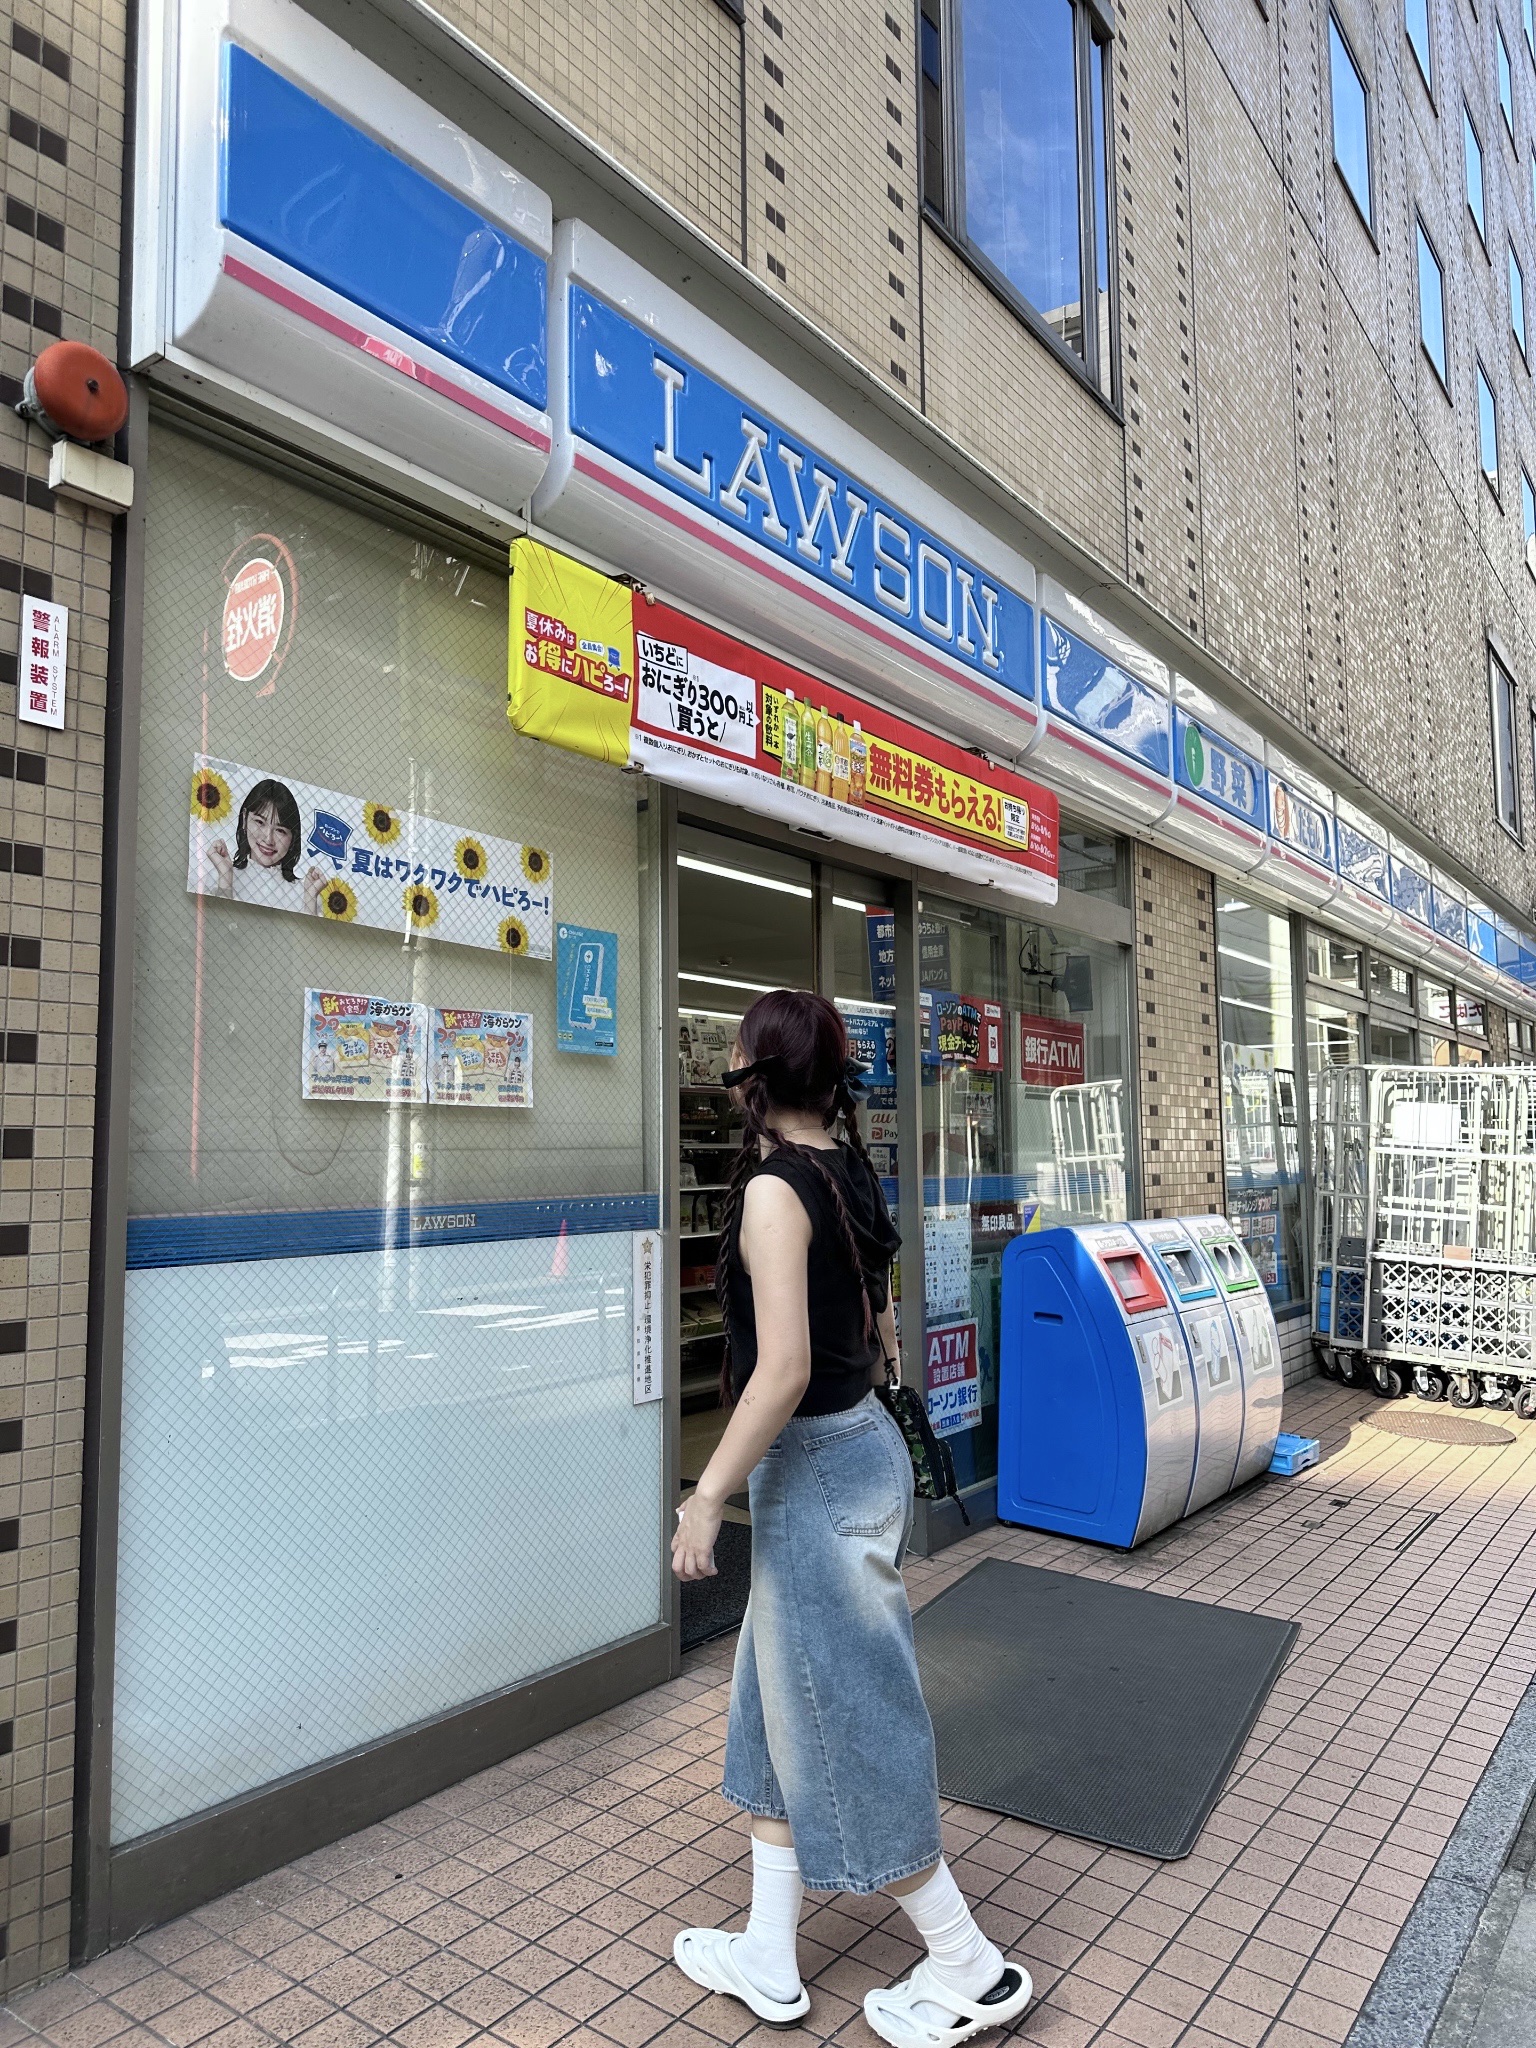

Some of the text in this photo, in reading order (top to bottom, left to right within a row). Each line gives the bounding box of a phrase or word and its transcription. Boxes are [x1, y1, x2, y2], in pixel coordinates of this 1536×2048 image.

[654, 356, 1001, 669] LAWSON
[526, 610, 575, 646] 夏休みは
[29, 609, 51, 713] 警報装置
[50, 616, 60, 716] ALARM SYSTEM
[525, 640, 630, 699] お得にハピろー!
[642, 639, 684, 667] いちどに
[677, 704, 719, 741] 買うと
[765, 693, 773, 748] 対象の飲料
[869, 743, 1002, 833] 無料券もらえる!
[1210, 747, 1247, 809] 野菜
[351, 847, 549, 915] 夏はワクワクでハピろー!
[370, 1001, 415, 1017] 海からクン
[482, 1014, 522, 1028] 海からクン
[857, 1051, 876, 1060] クーポン
[938, 1033, 979, 1057] 現金チャージ!
[1025, 1036, 1080, 1069] 銀行ATM
[413, 1213, 476, 1231] LAWSON
[928, 1331, 969, 1367] ATM
[932, 1362, 966, 1384] 設置店舗
